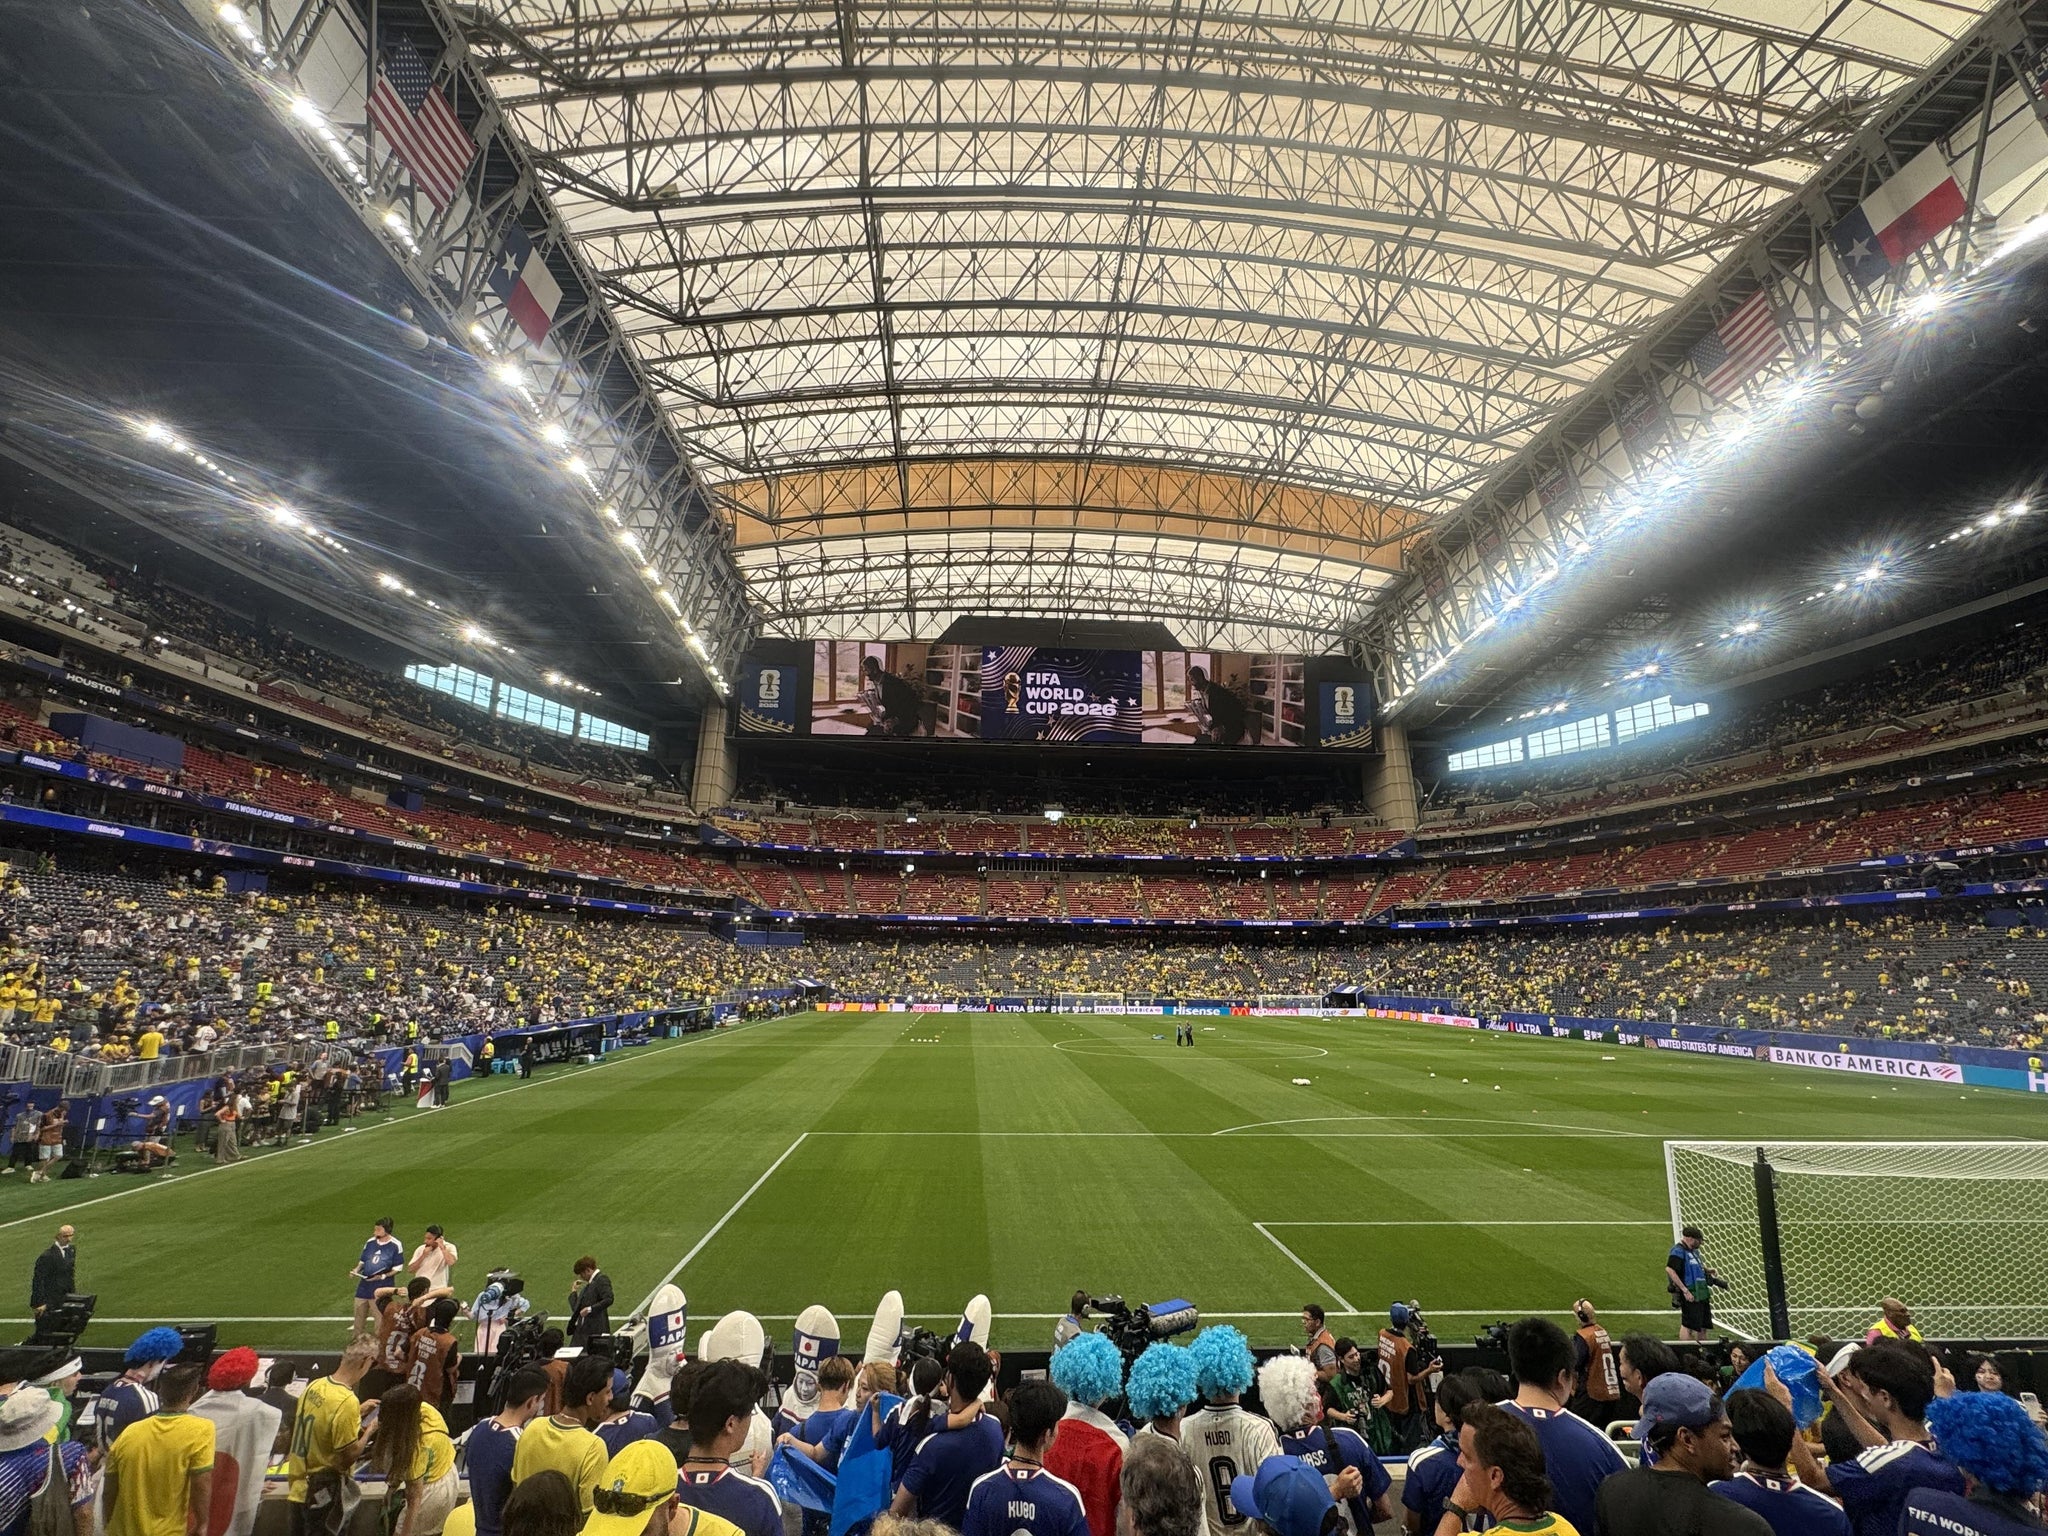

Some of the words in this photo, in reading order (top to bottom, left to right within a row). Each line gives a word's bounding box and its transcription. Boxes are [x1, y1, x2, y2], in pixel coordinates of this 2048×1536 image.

[66, 673, 121, 696] HOUSTON
[1026, 672, 1061, 685] FIFA
[1026, 687, 1084, 700] WORLD
[1026, 701, 1058, 715] CUP
[1060, 702, 1117, 716] 2026
[144, 783, 183, 798] HOUSTON
[226, 802, 239, 811] FIFA
[240, 806, 262, 816] WORLD
[262, 810, 274, 819] CUP
[273, 813, 294, 823] 2026
[393, 840, 426, 850] HOUSTON
[1569, 835, 1596, 843] HOUSTON
[1956, 846, 1994, 857] HOUSTON
[283, 856, 315, 867] HOUSTON
[1781, 867, 1823, 877] HOUSTON
[911, 1004, 940, 1012] erizon
[996, 1005, 1026, 1013] ULTRA
[1173, 1007, 1220, 1015] Hisense
[1515, 1022, 1542, 1035] ULTRA
[1657, 1038, 1681, 1049] UNITED
[1682, 1040, 1707, 1052] STATES
[1707, 1043, 1717, 1053] OF
[1718, 1044, 1754, 1057] AMERICA
[1776, 1050, 1817, 1065] BANK
[1821, 1054, 1842, 1067] OF
[1847, 1056, 1931, 1078] AMERICA
[420, 1336, 437, 1346] MEDIA
[794, 1352, 822, 1369] JAPA
[1204, 1430, 1231, 1446] KUBO
[1008, 1501, 1035, 1520] KUBO
[1908, 1507, 1938, 1525] FIFA
